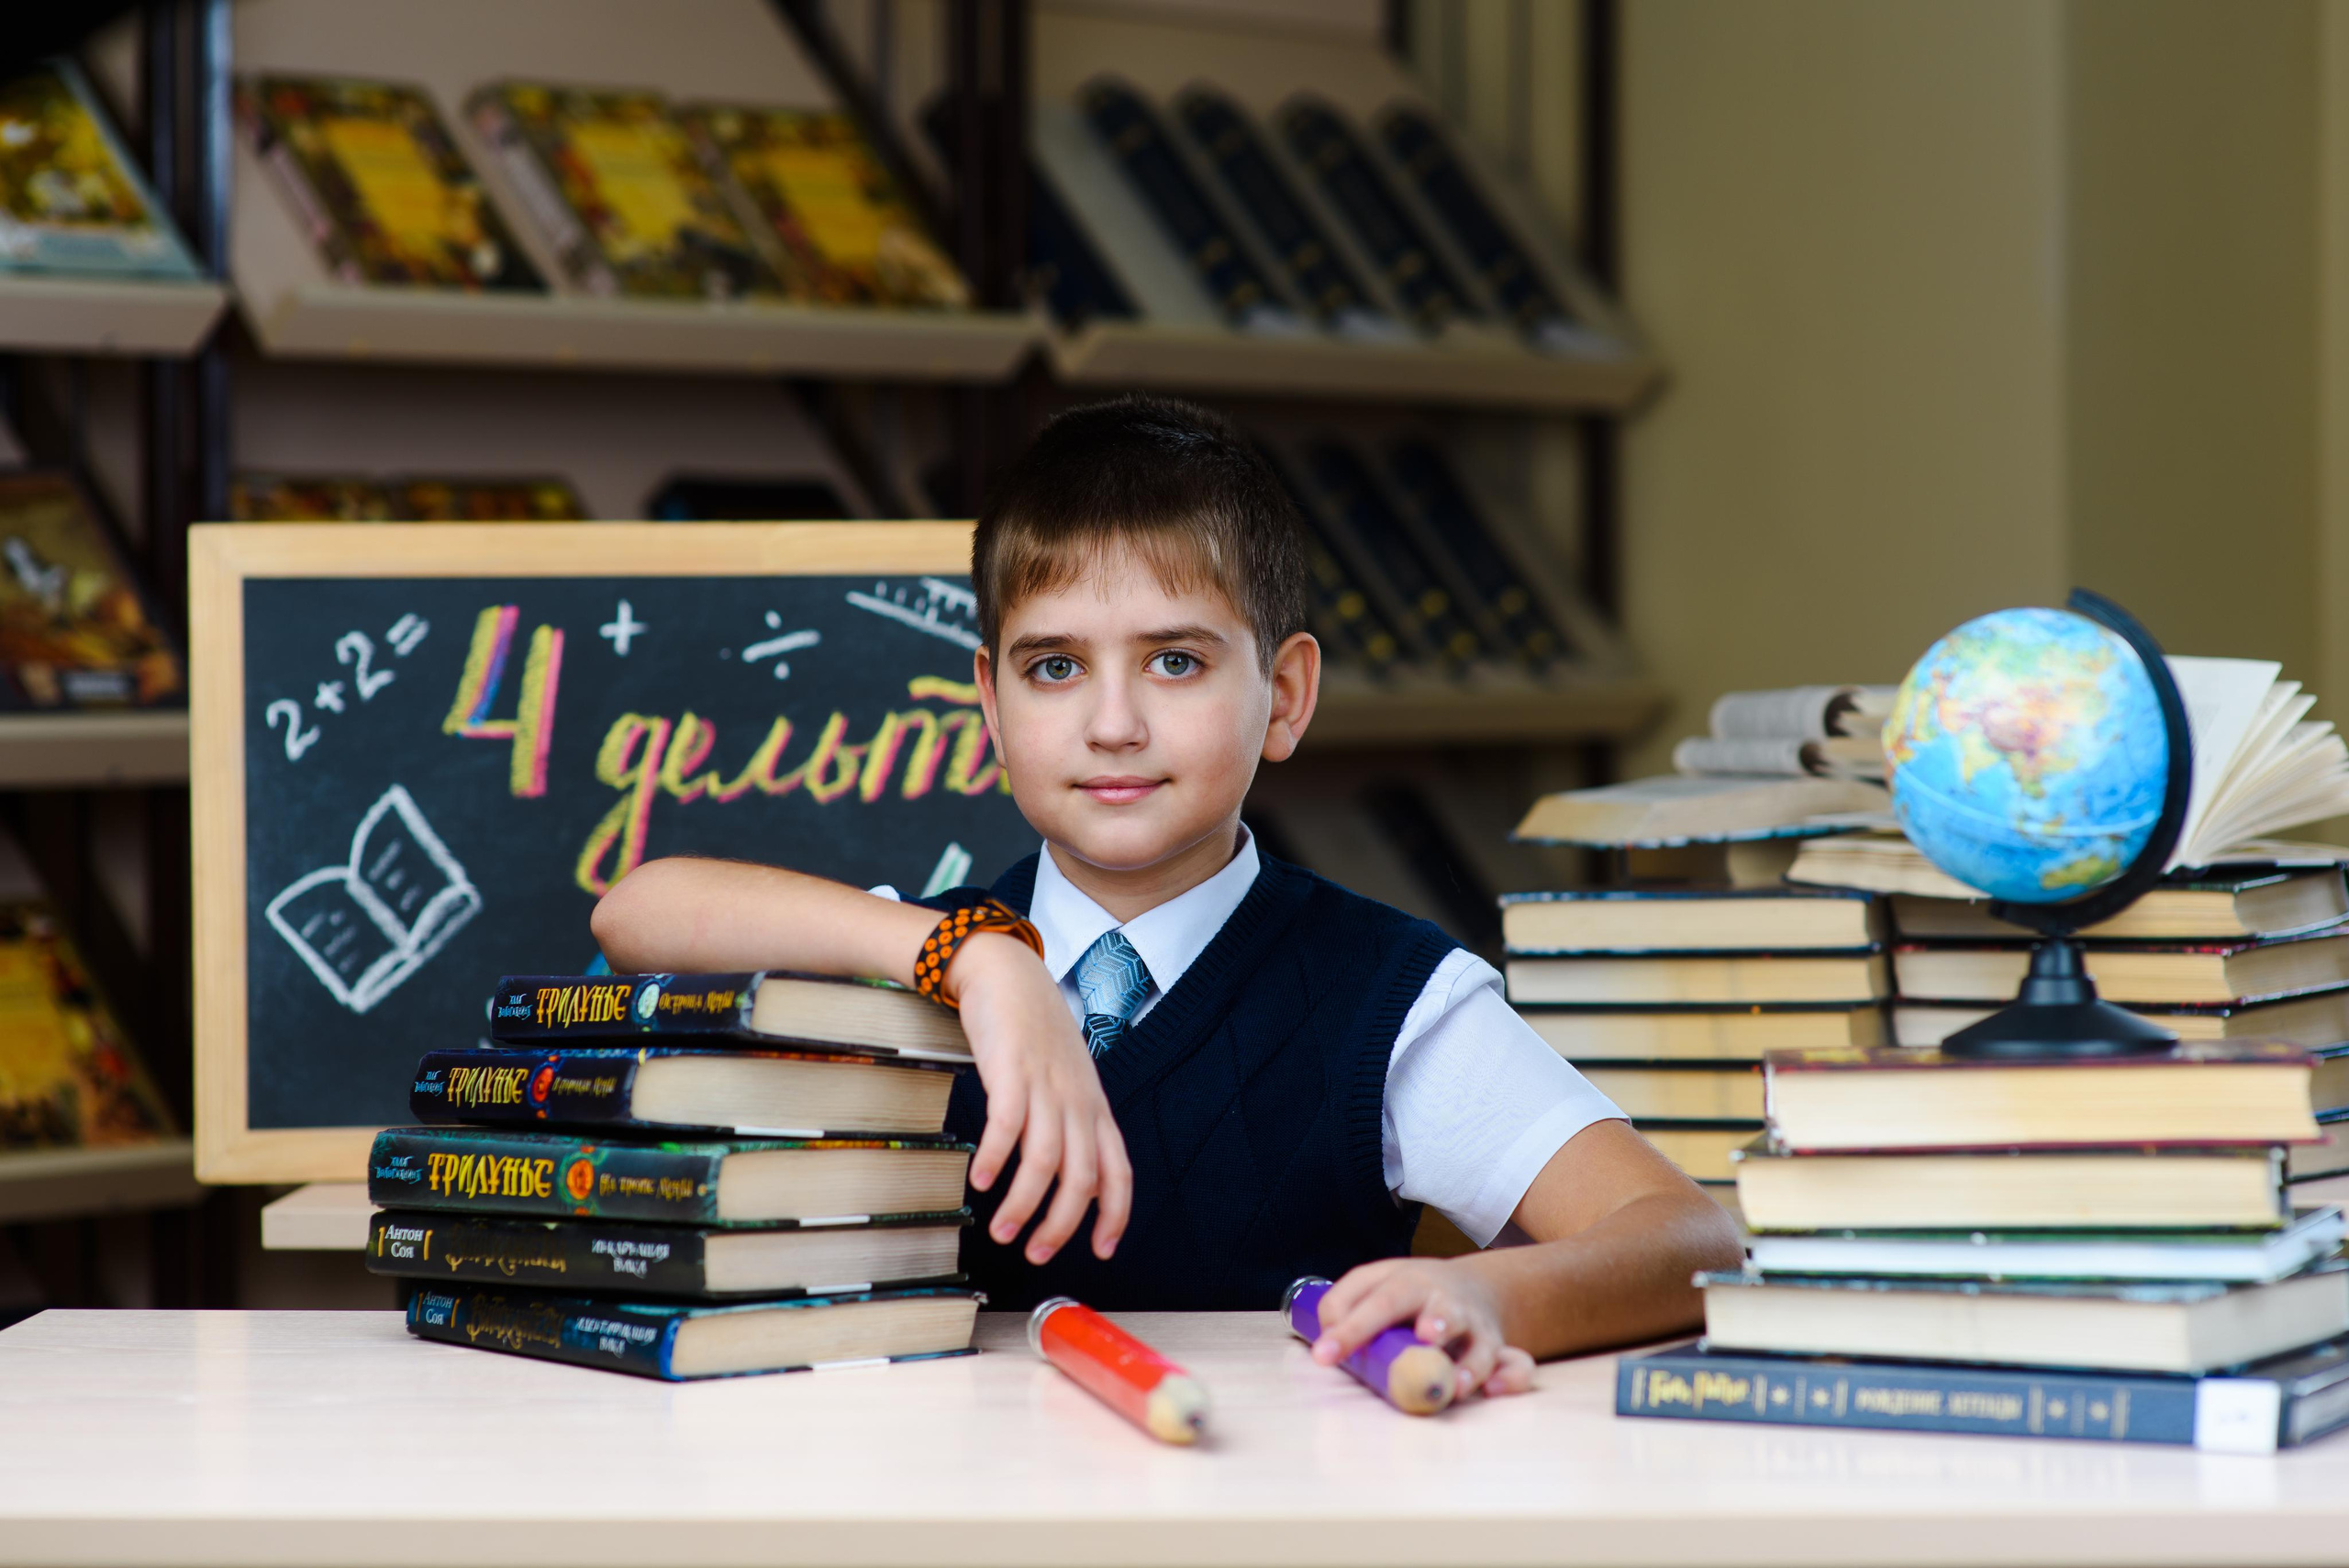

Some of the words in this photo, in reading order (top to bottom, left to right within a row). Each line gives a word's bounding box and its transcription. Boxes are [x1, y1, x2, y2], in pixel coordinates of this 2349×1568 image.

[442, 605, 564, 798] 4
[575, 674, 1011, 898] дельт
[428, 1152, 555, 1199] ТРИЛУНЬЕ
